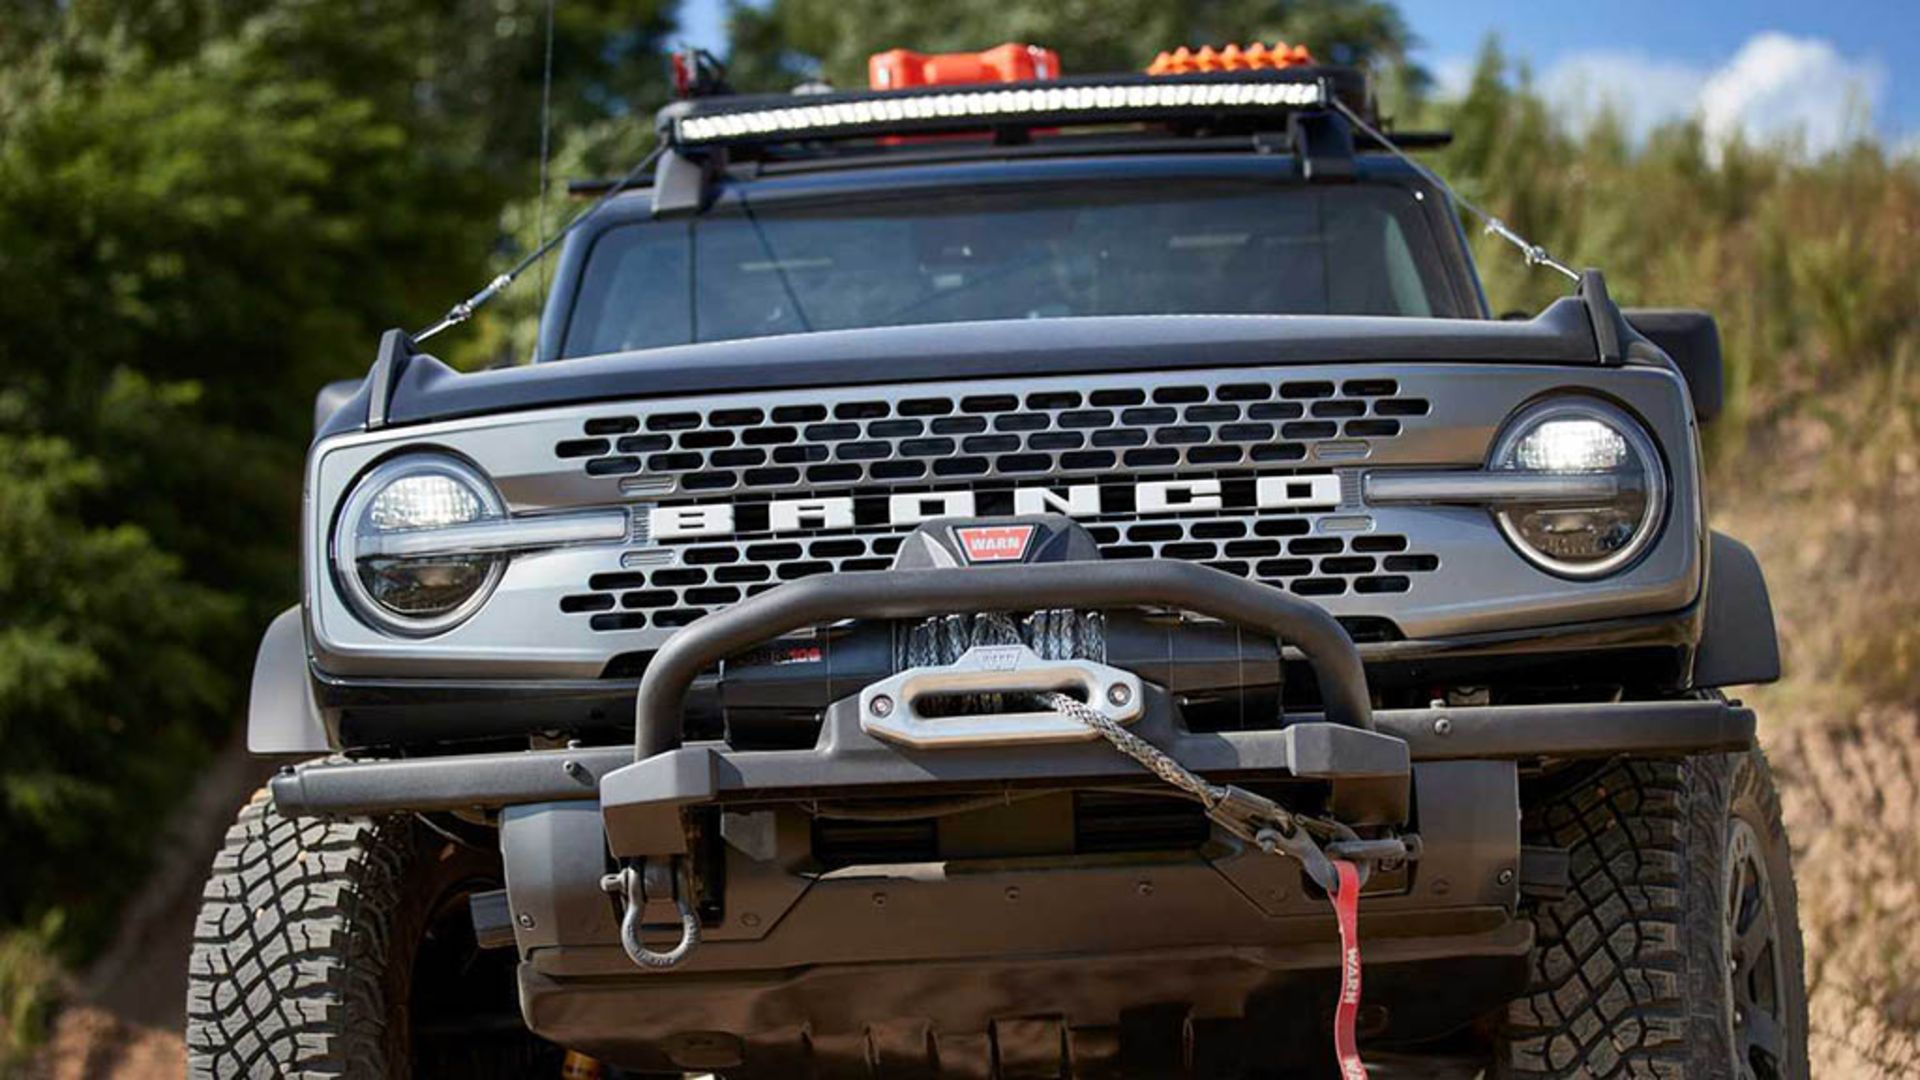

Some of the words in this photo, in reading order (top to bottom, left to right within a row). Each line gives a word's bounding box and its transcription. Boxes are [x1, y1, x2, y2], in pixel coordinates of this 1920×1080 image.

[649, 474, 1342, 540] BRONCO
[971, 536, 1019, 550] WARN
[1345, 947, 1360, 1004] WARN
